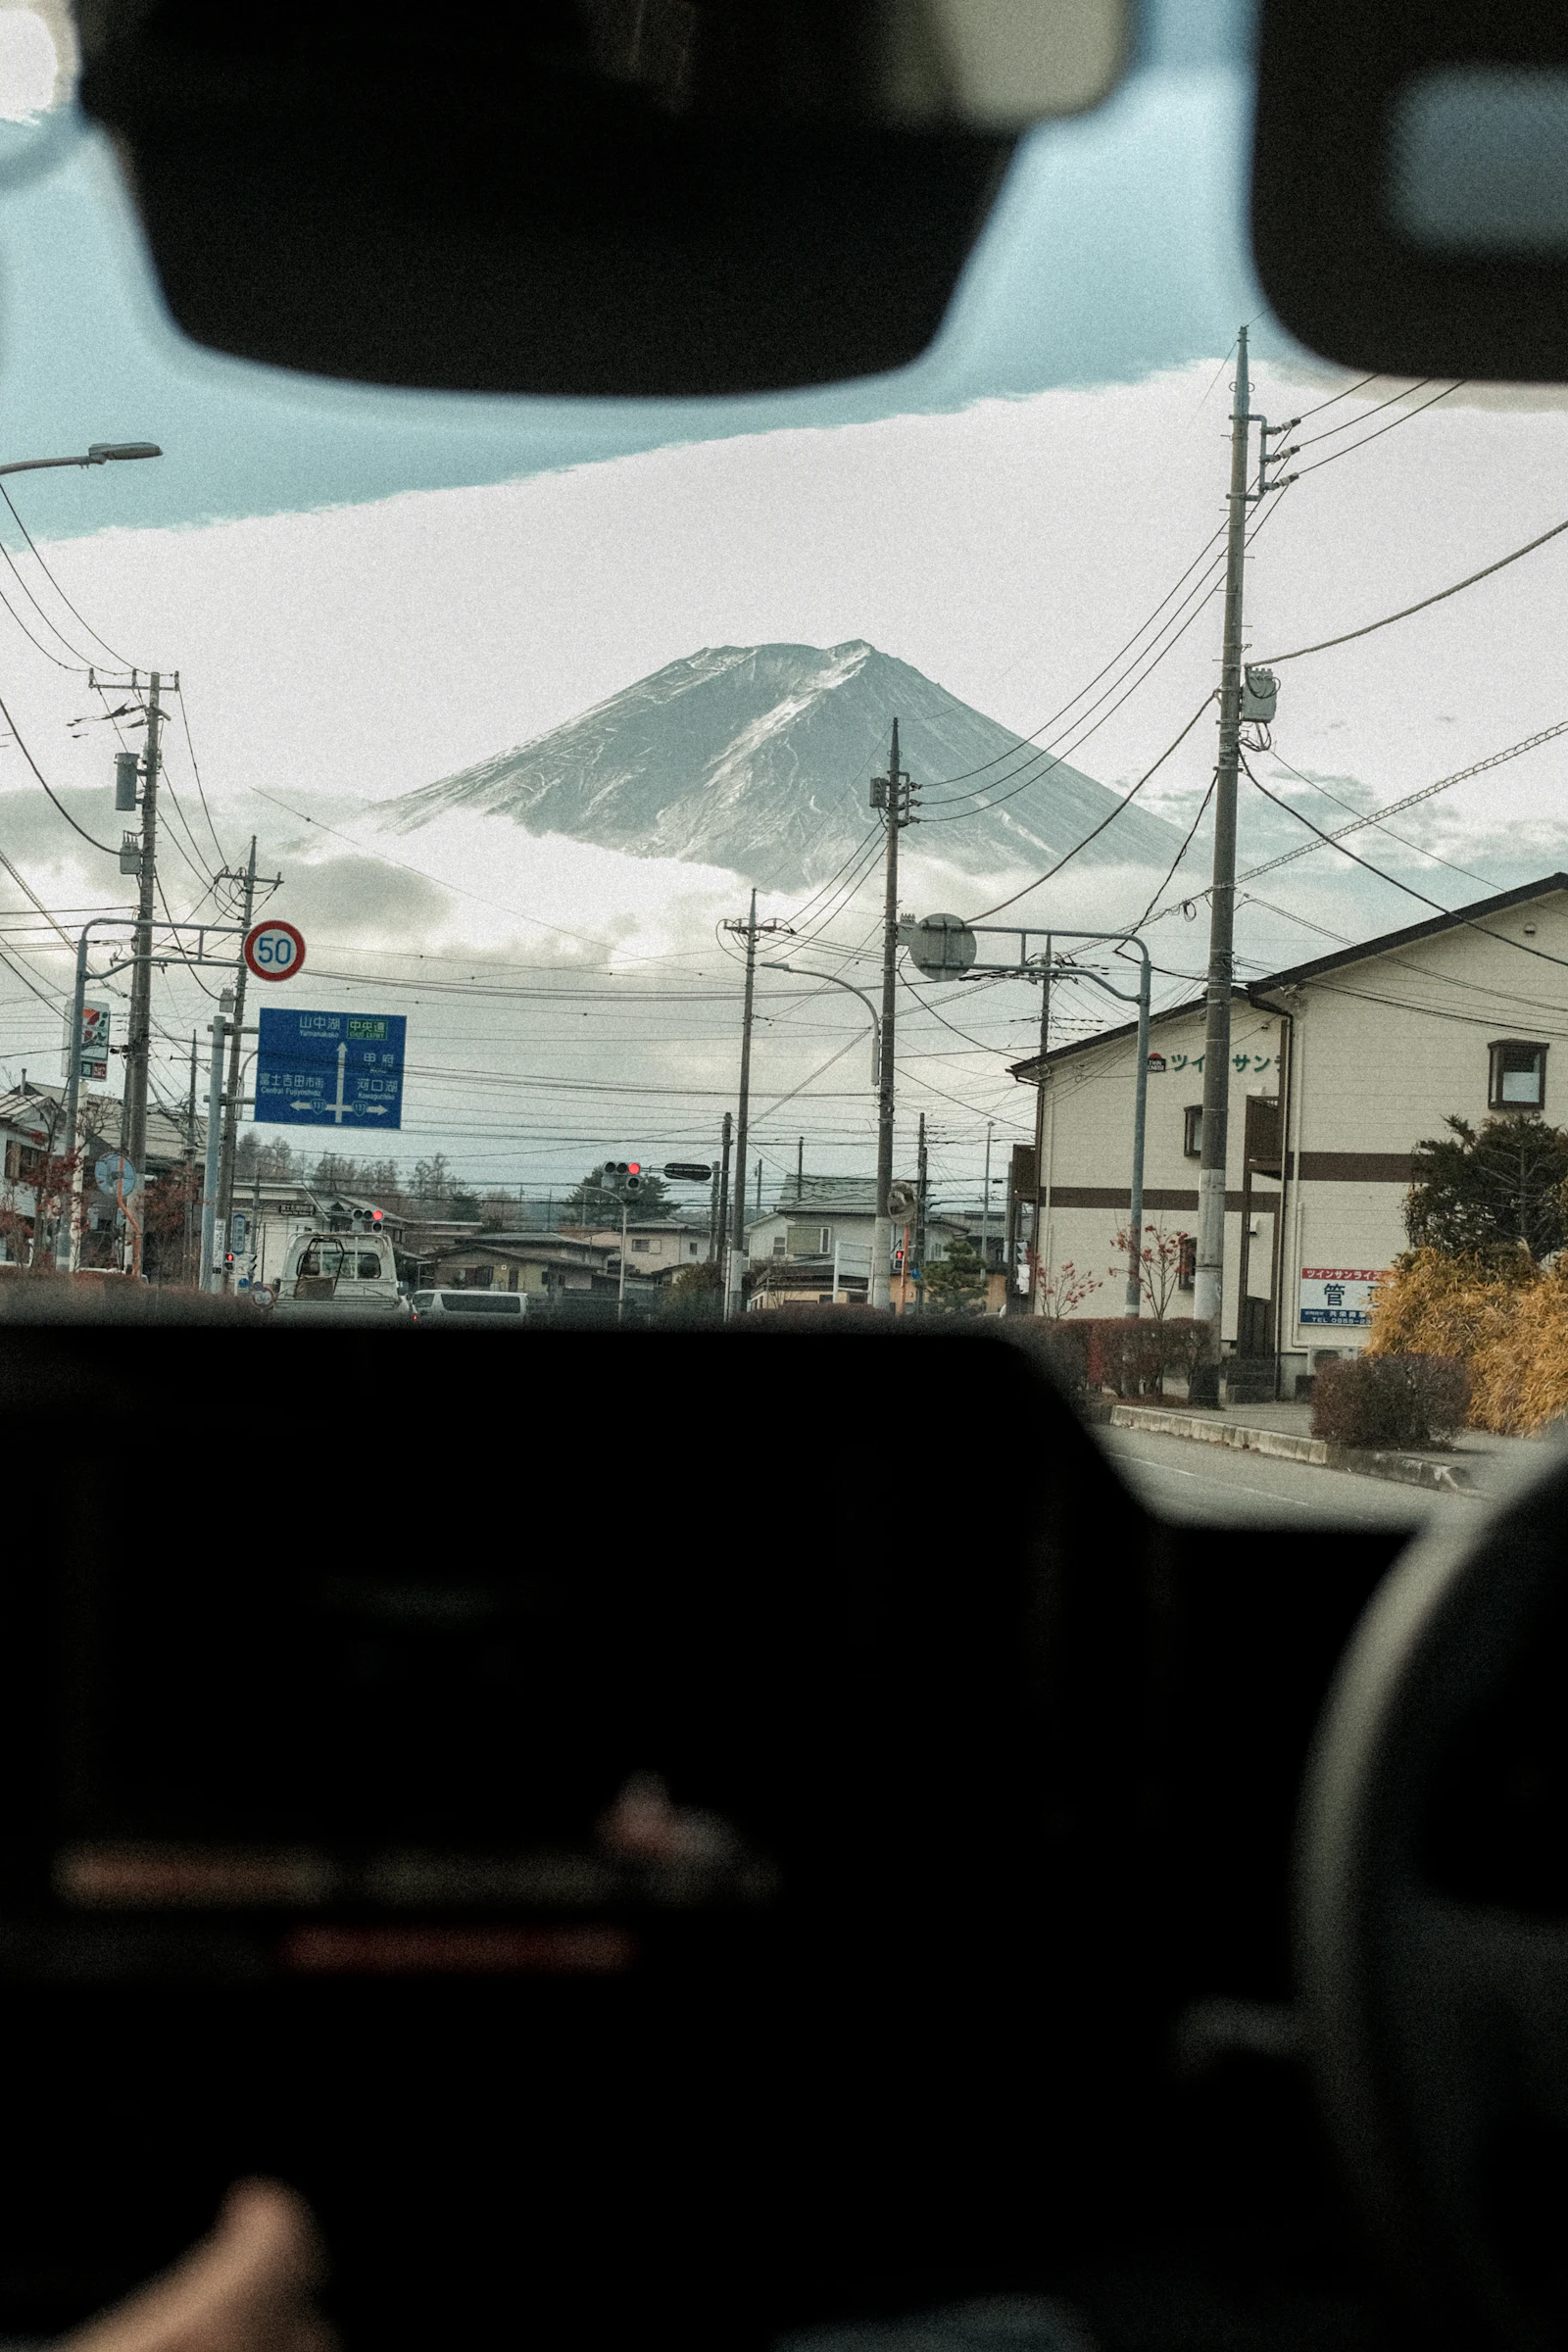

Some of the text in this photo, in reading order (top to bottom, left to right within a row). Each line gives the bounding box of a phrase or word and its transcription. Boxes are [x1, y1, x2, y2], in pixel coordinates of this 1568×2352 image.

[258, 937, 291, 965] 50
[299, 1015, 341, 1030] 山中湖
[349, 1020, 385, 1033] 中央道
[364, 1053, 394, 1067] 甲府
[259, 1073, 324, 1089] 富士吉田市街
[357, 1078, 399, 1093] 河口湖
[313, 1101, 324, 1109] 137
[355, 1103, 367, 1112] 137
